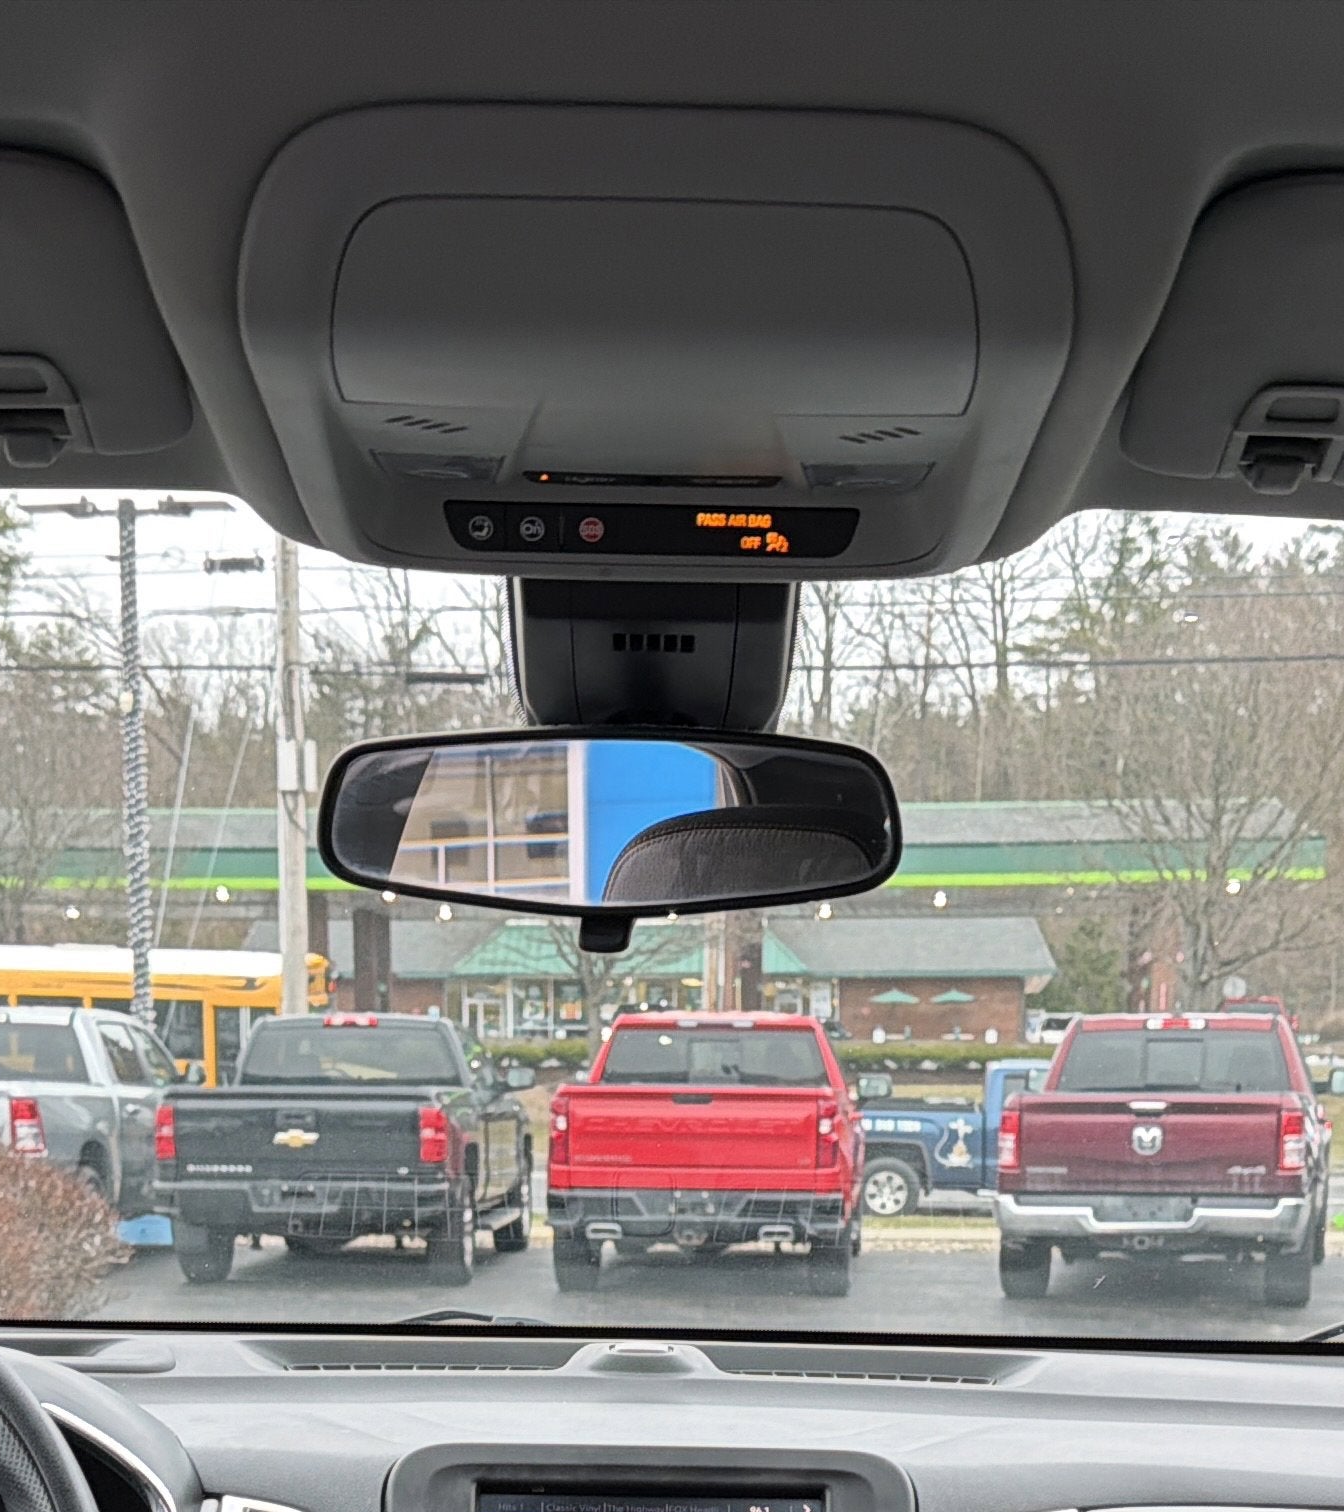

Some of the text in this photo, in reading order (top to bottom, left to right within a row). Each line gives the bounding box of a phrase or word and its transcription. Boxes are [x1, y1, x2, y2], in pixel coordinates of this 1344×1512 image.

[696, 513, 726, 528] PASS
[728, 514, 746, 528] AIR
[740, 535, 762, 550] OFF
[546, 1503, 577, 1512] Classic
